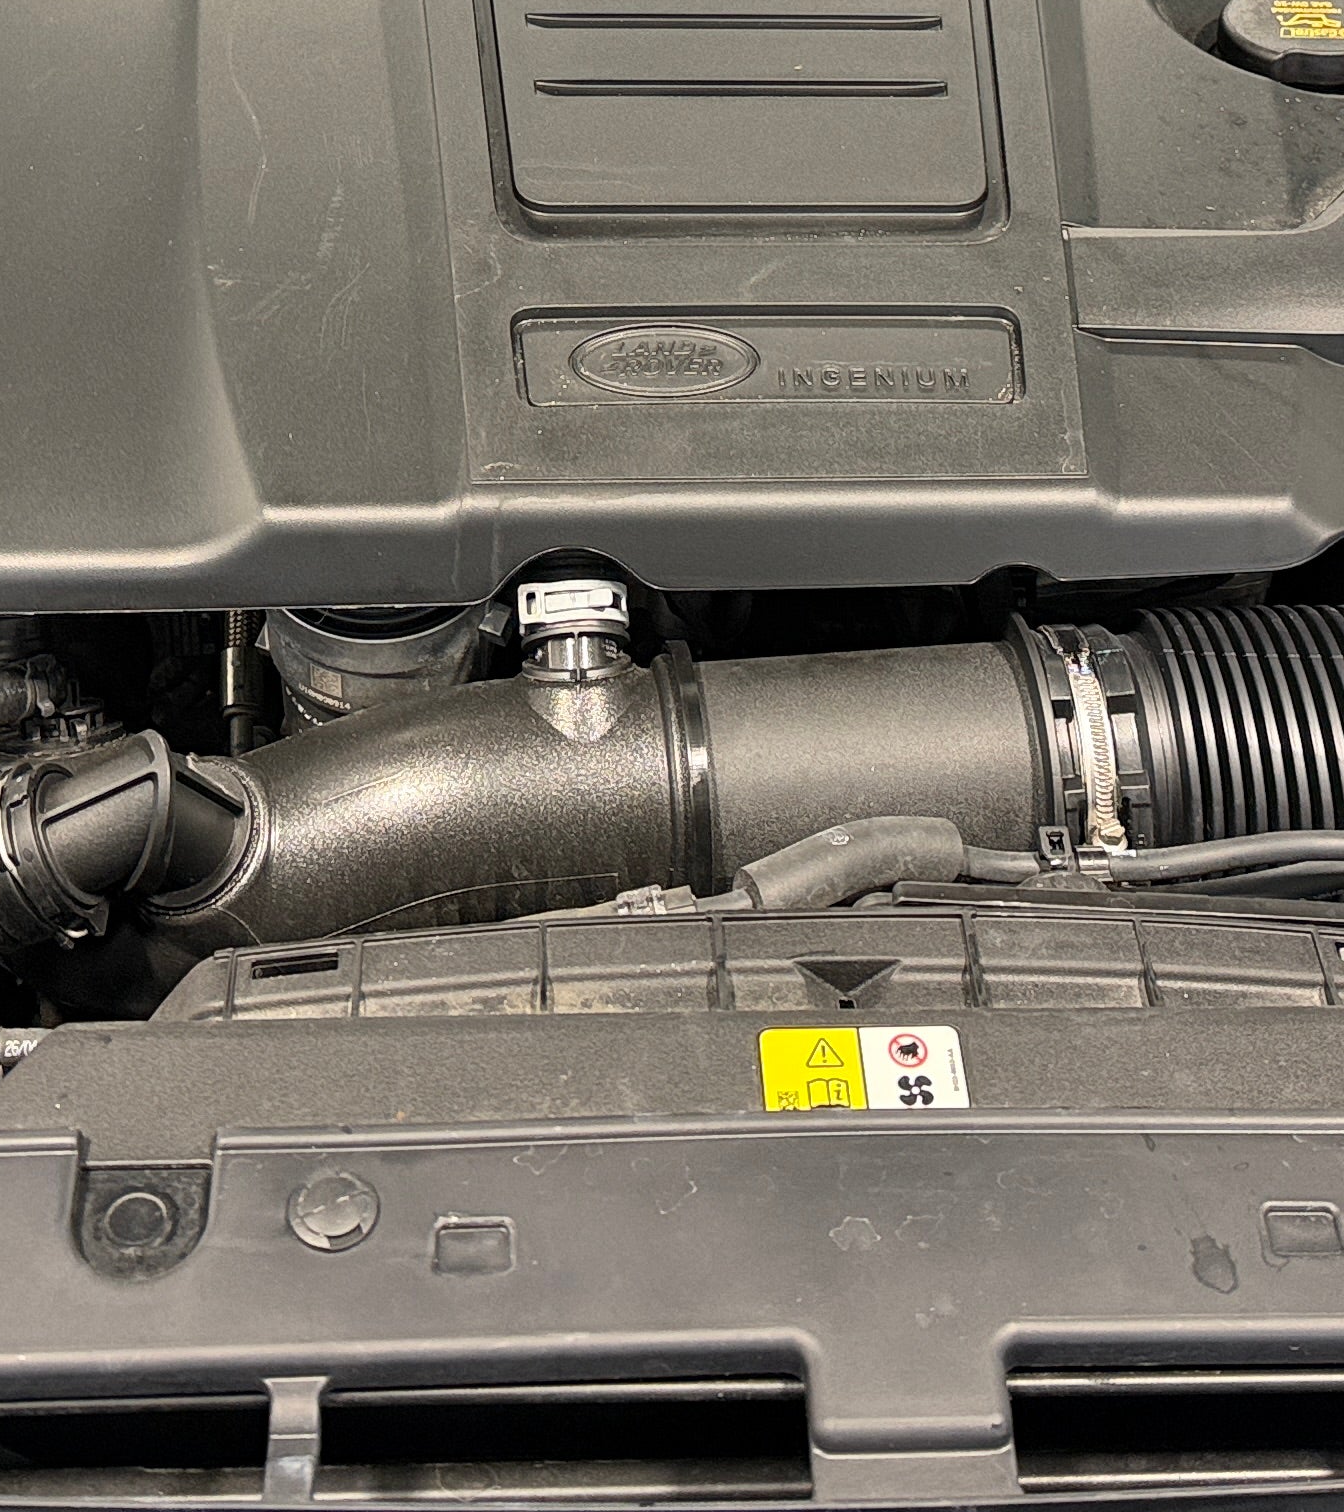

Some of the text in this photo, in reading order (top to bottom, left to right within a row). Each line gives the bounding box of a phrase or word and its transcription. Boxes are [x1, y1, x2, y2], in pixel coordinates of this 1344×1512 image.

[611, 339, 694, 357] LAND
[617, 358, 725, 378] ROVER
[776, 365, 972, 389] INGENIUM
